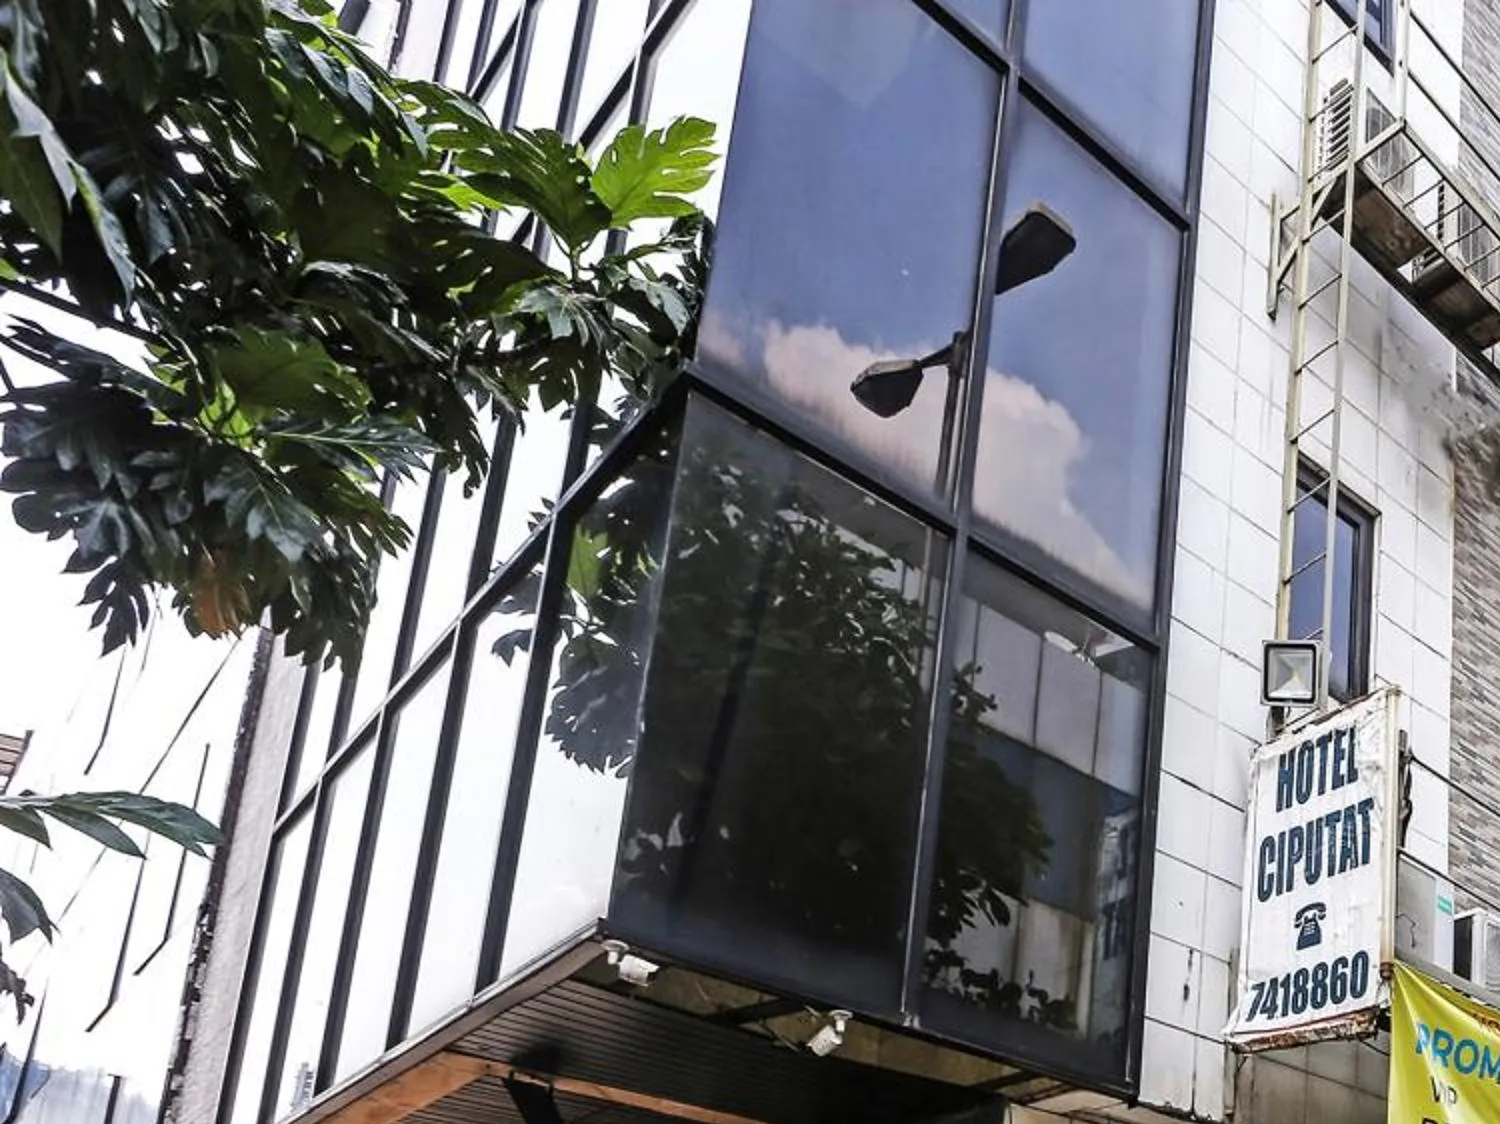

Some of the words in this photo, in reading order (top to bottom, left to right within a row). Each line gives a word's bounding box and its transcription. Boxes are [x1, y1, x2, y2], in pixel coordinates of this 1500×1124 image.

[1275, 725, 1358, 812] HOTEL
[1257, 797, 1375, 903] CIPUTAT
[1245, 950, 1369, 1023] 7418860
[1430, 1076, 1458, 1105] VIP
